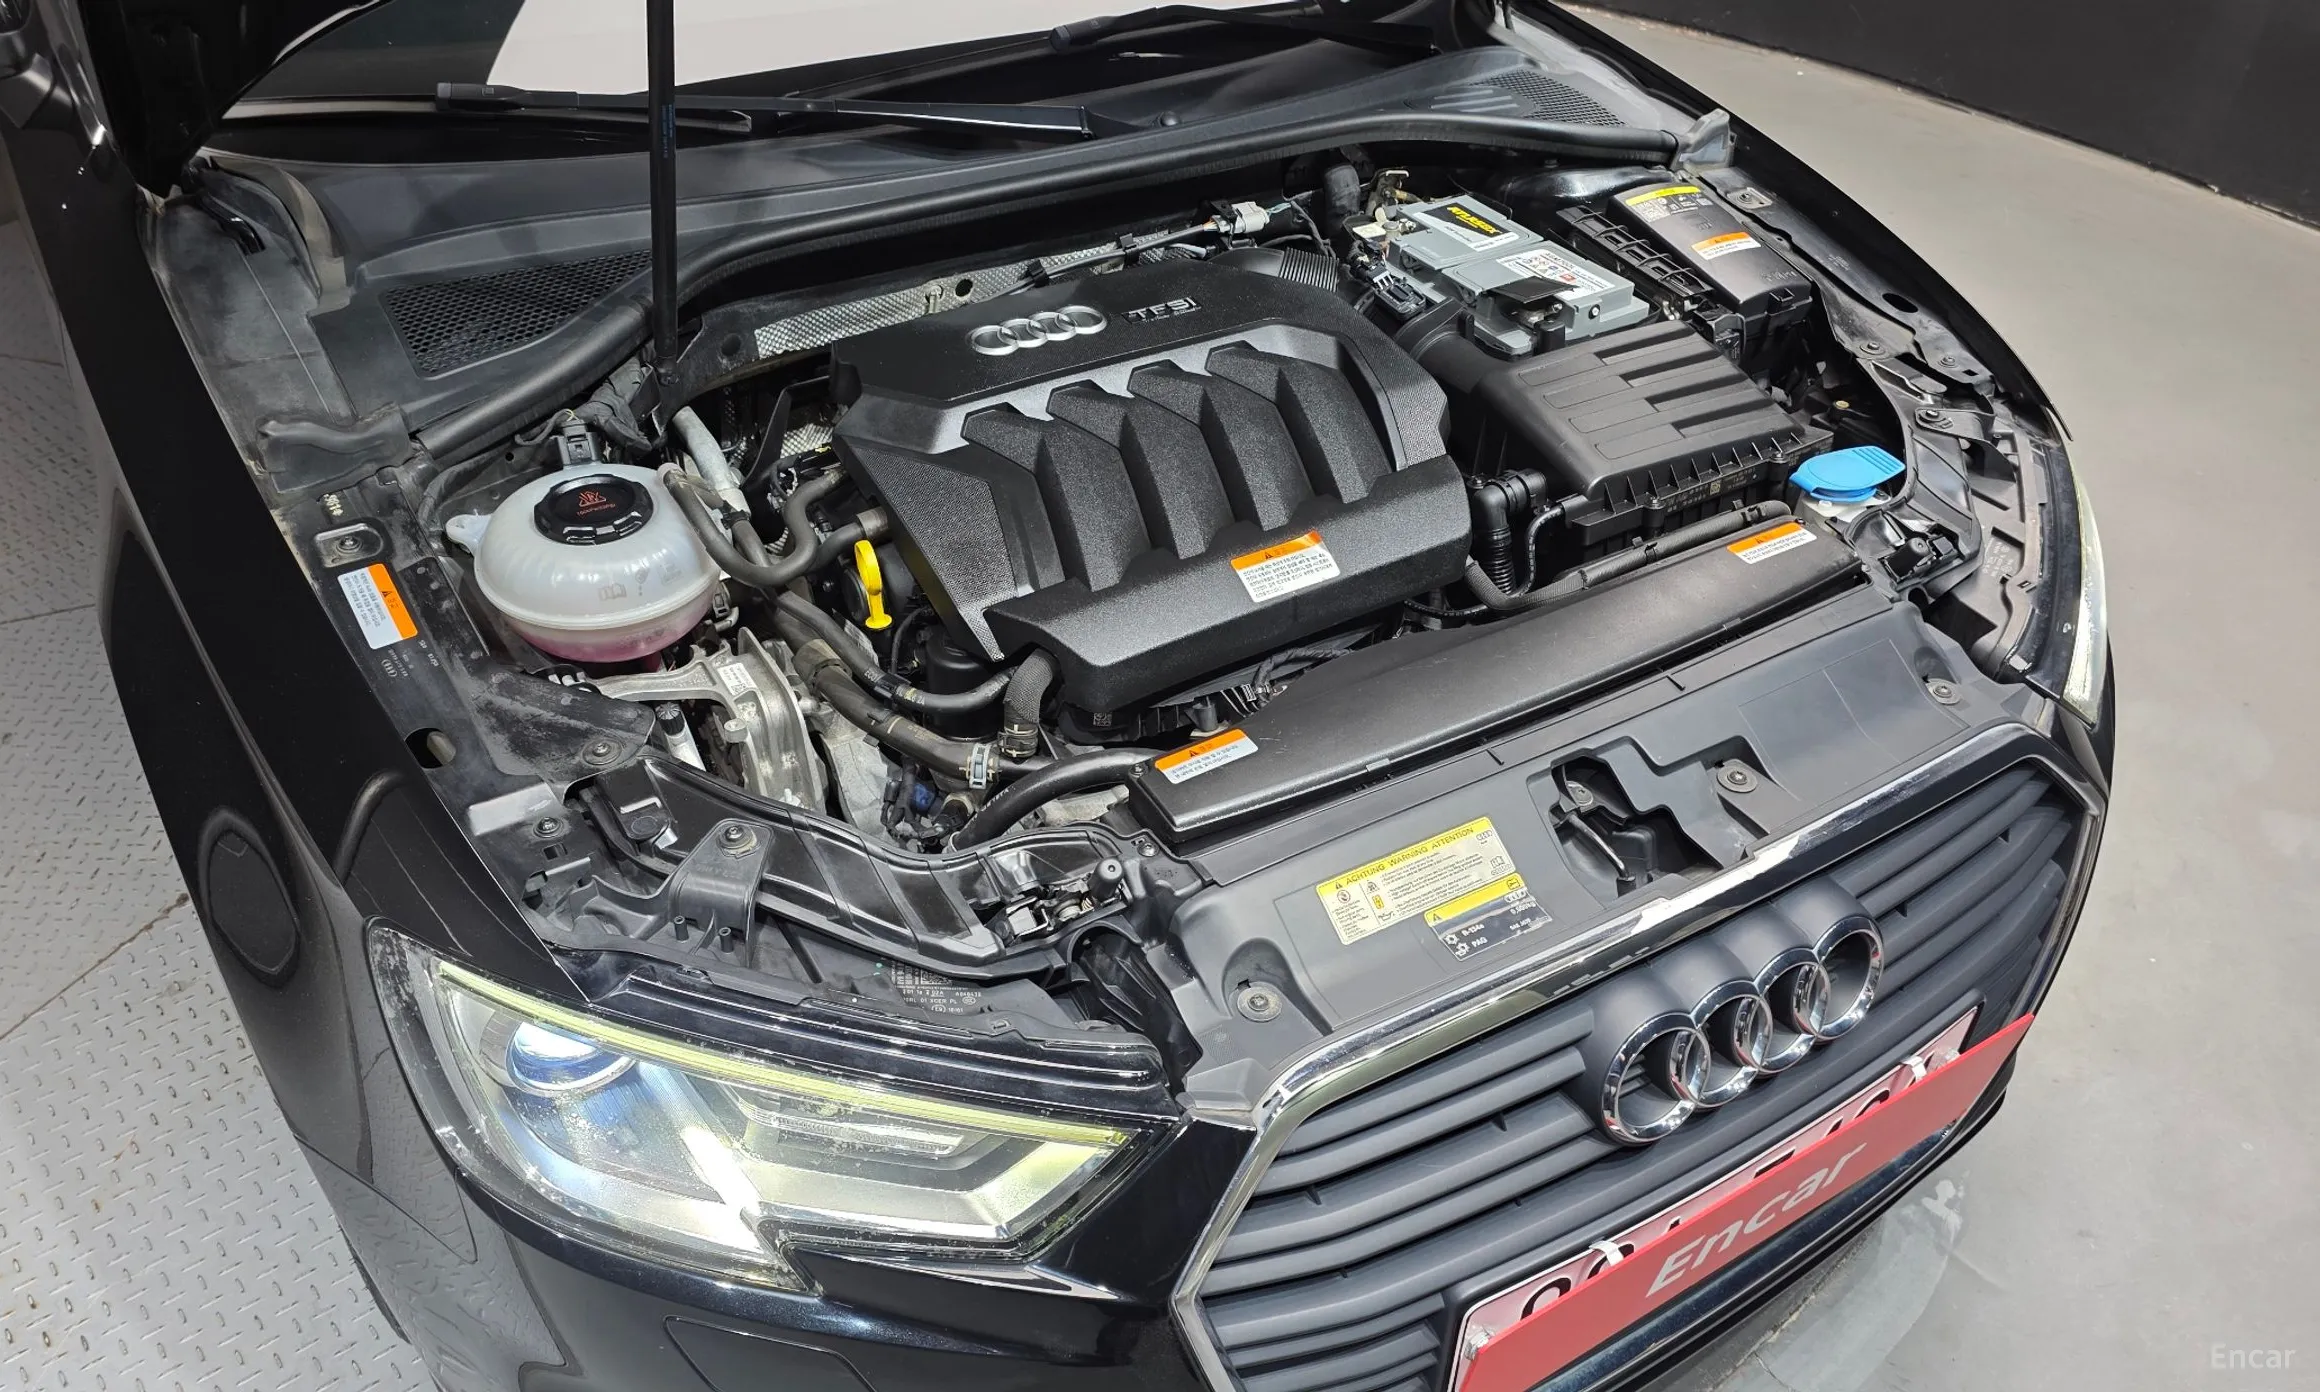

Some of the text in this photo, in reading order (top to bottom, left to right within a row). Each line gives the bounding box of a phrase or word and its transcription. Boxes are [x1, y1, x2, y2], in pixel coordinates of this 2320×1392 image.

[1128, 297, 1197, 318] TFSI
[1346, 863, 1386, 885] ACHTUNG
[1388, 846, 1429, 867] WARNING
[1431, 828, 1474, 850] ATTENTION
[1471, 936, 1488, 948] PAG
[1646, 1143, 1866, 1298] Encar
